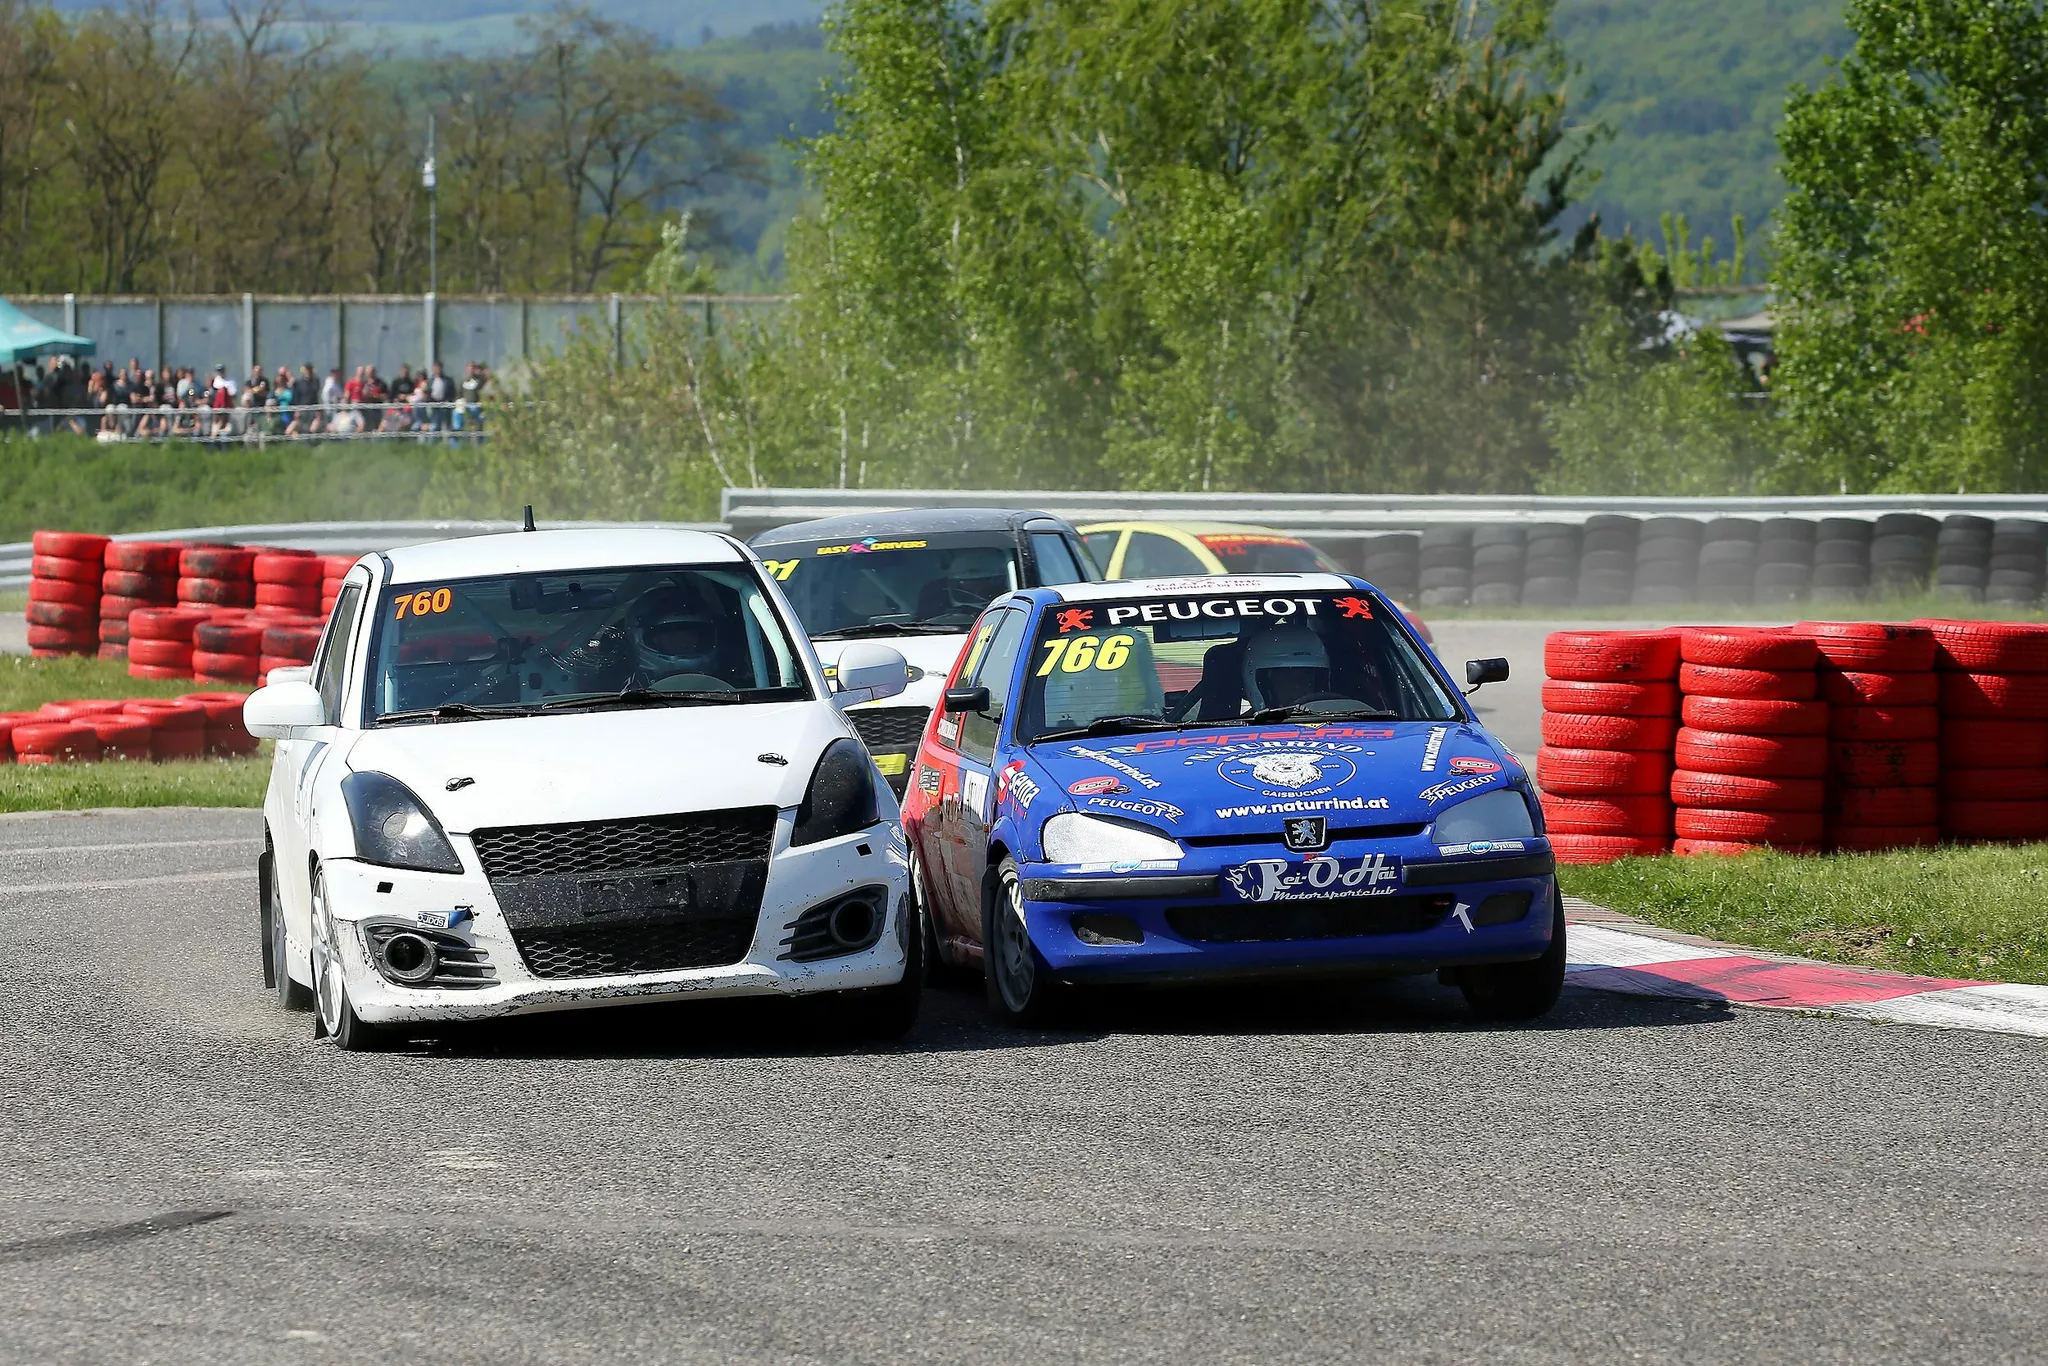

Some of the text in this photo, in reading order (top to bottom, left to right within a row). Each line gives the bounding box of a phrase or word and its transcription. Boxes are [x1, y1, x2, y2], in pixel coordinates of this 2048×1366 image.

[816, 540, 927, 555] EASY DRIVERS
[394, 588, 452, 620] 760
[1107, 599, 1322, 625] PEUGEOT
[1036, 634, 1135, 677] 766
[1008, 771, 1041, 810] sema
[1262, 786, 1332, 798] GAISBUCHEN
[1437, 774, 1497, 800] PEUGEOT
[1088, 798, 1167, 817] PEUGEOT
[1215, 797, 1390, 819] www.naturrind.at
[1272, 886, 1398, 900] Motorsportclub
